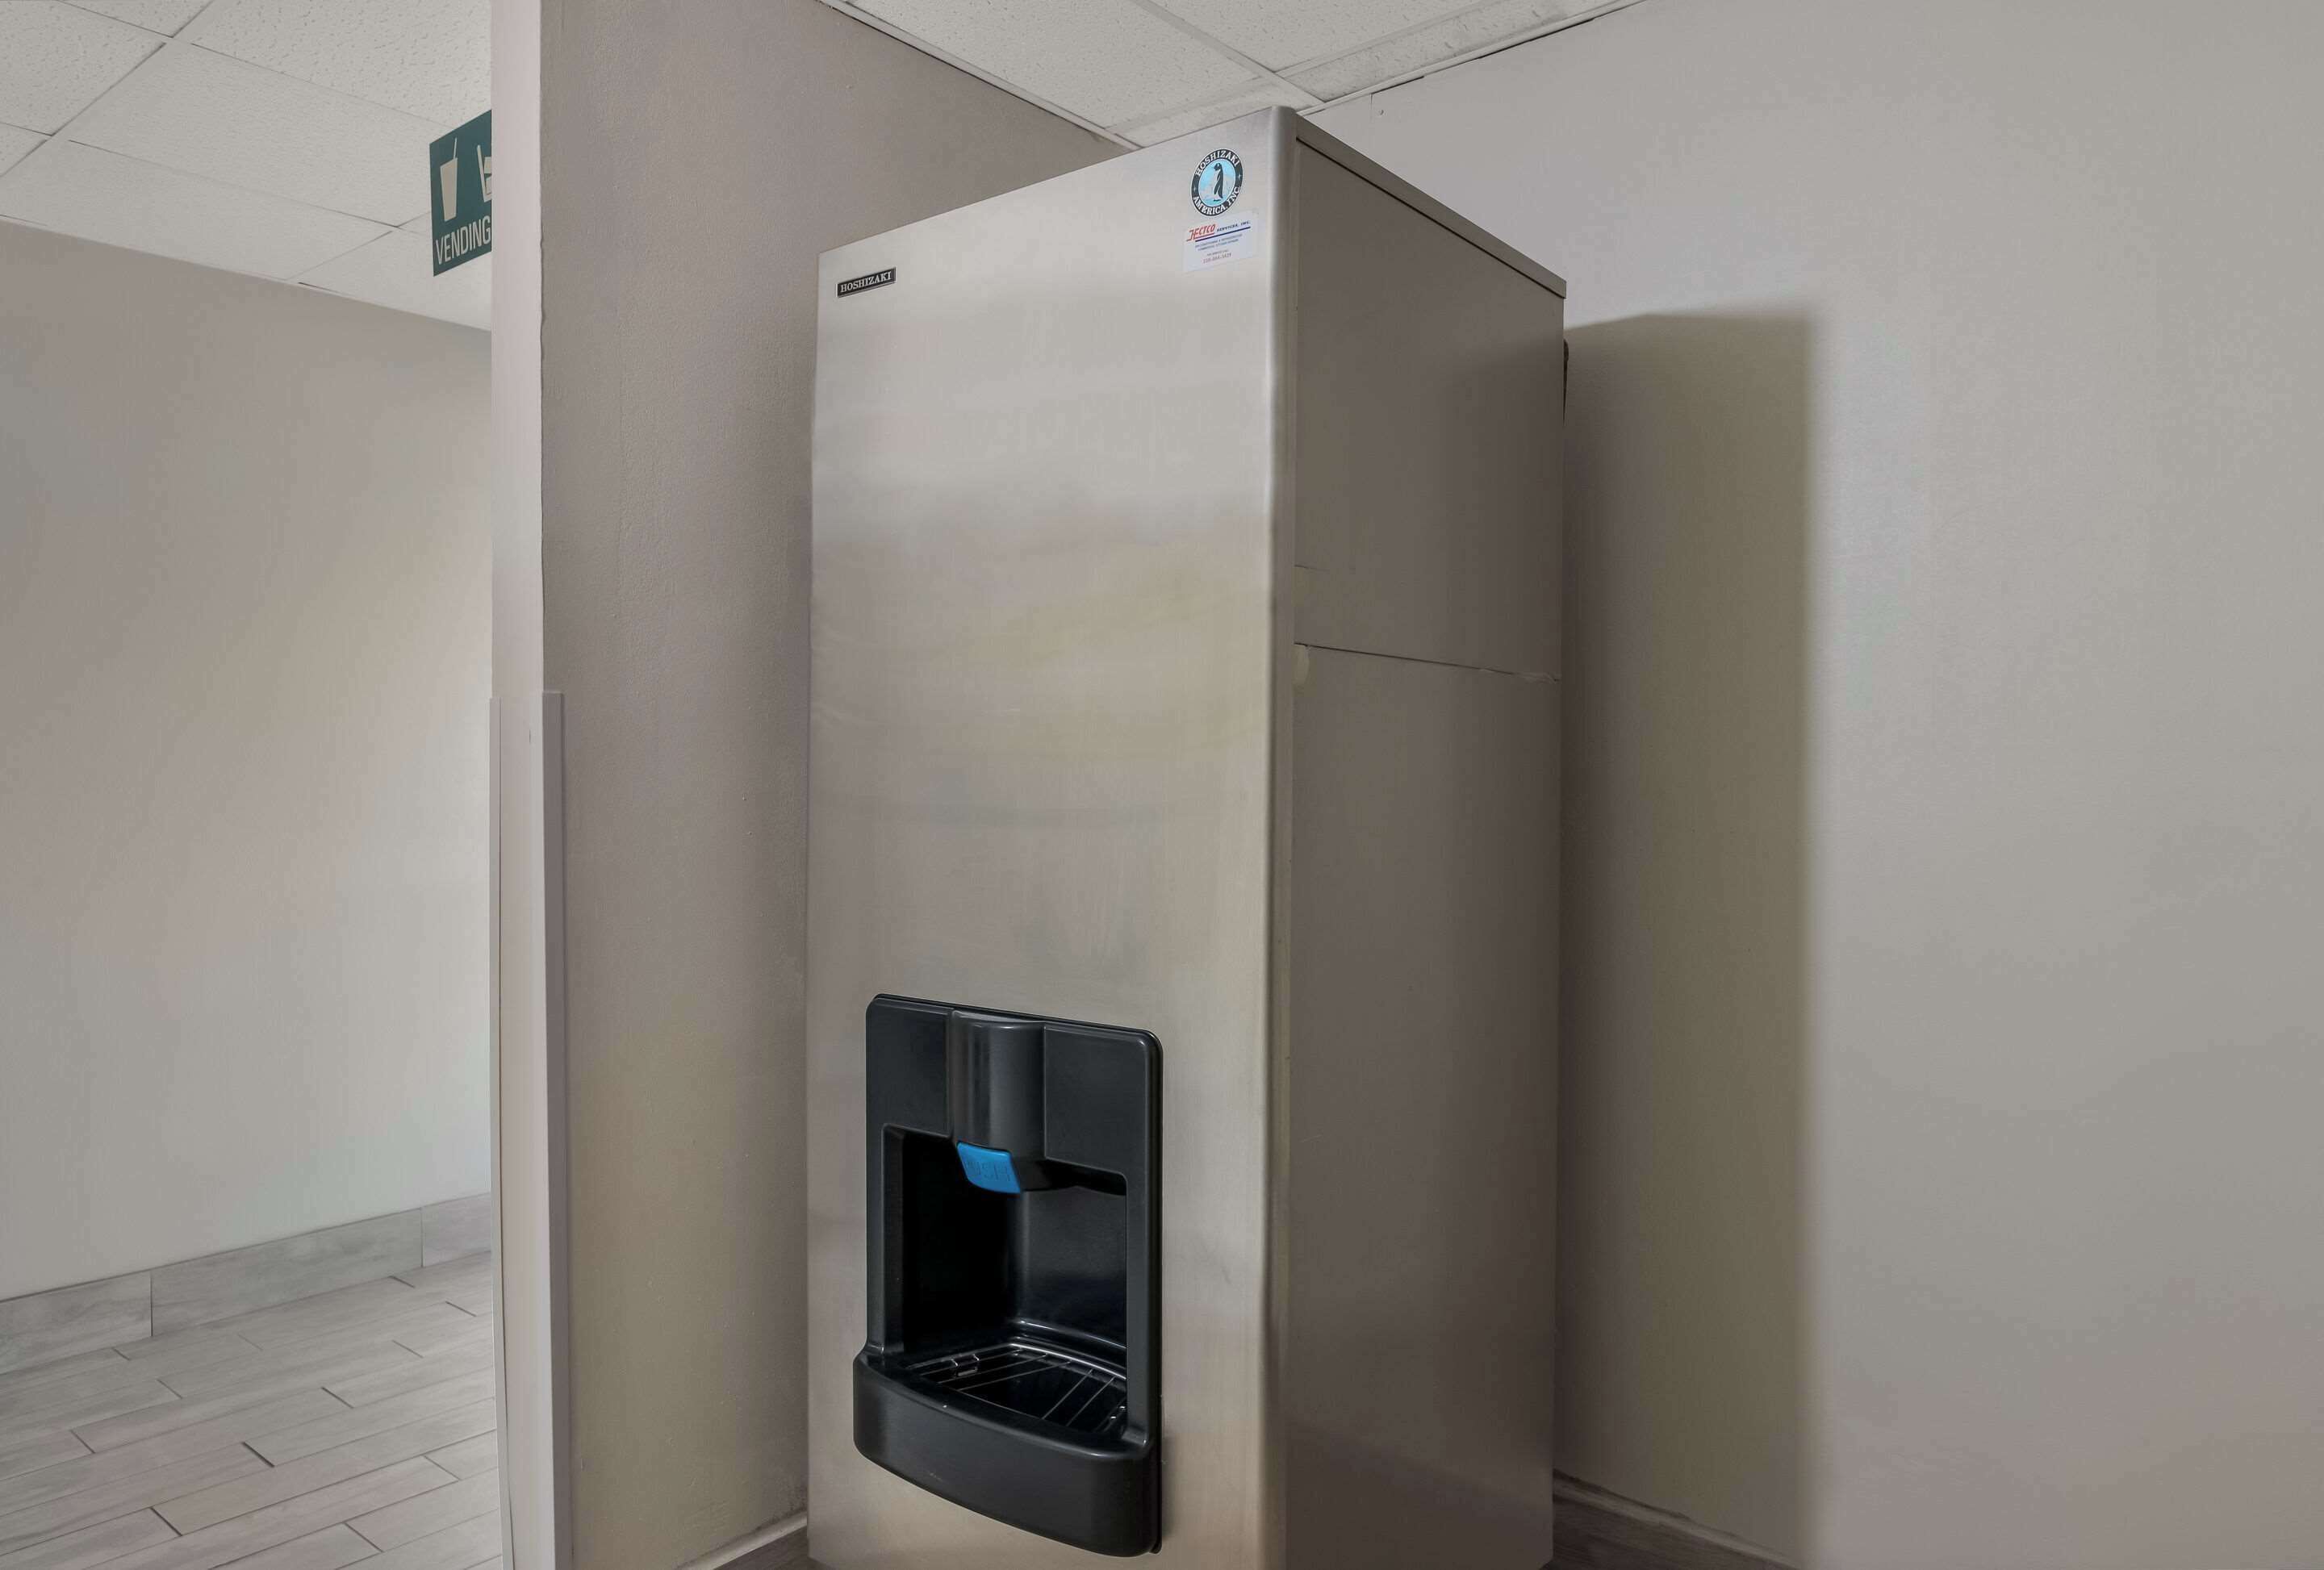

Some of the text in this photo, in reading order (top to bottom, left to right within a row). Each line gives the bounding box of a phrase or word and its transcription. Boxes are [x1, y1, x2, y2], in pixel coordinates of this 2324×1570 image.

[1194, 150, 1240, 177] HOSHIZAKI
[435, 215, 491, 266] VENDING
[840, 270, 892, 293] HOSHIZAKI
